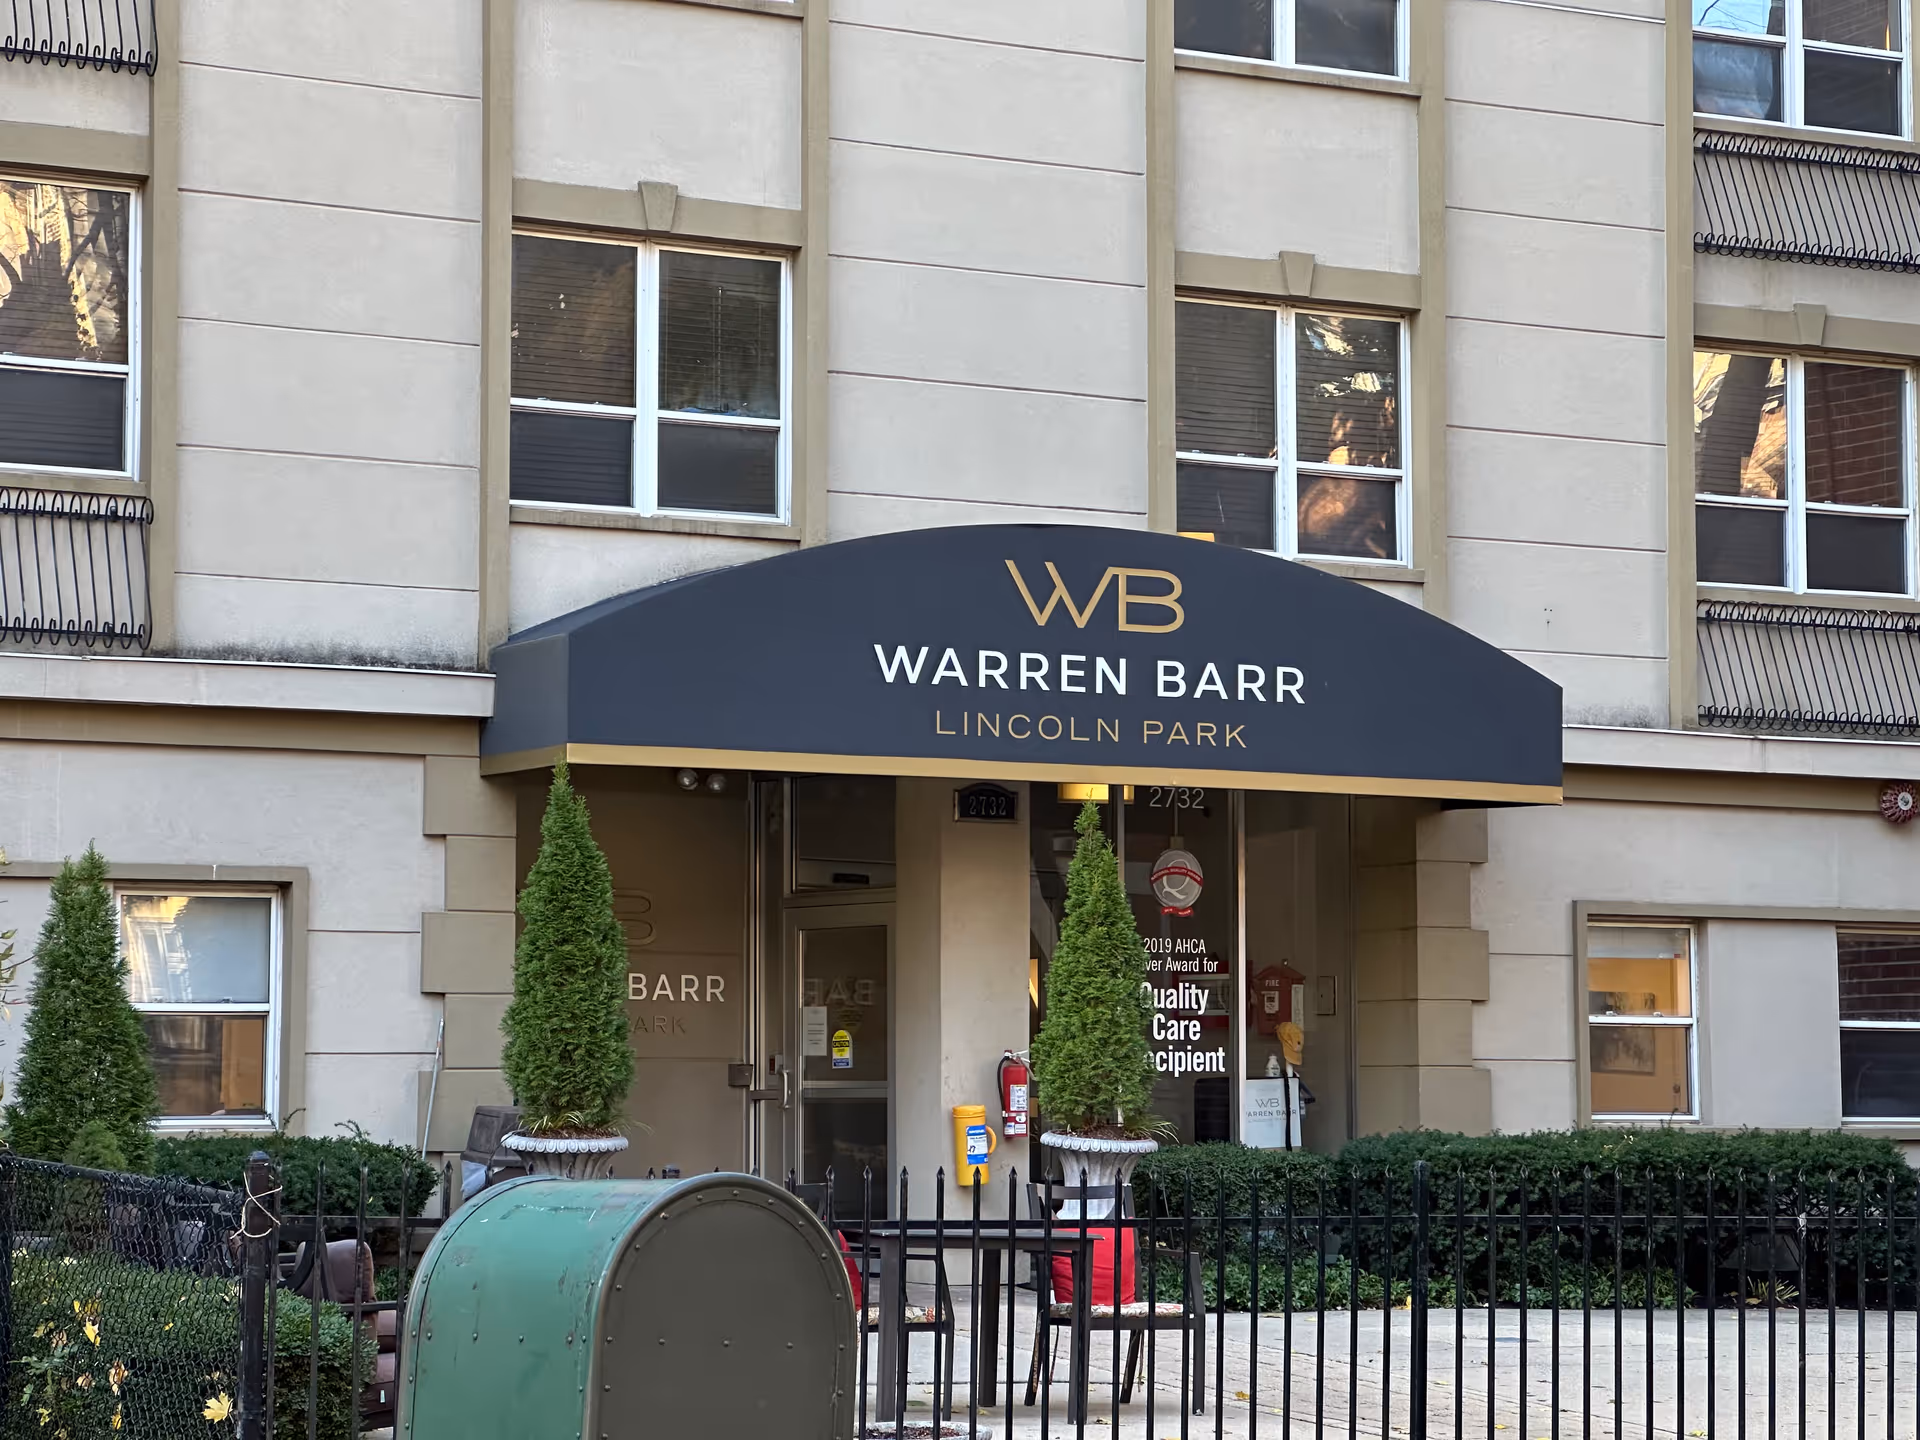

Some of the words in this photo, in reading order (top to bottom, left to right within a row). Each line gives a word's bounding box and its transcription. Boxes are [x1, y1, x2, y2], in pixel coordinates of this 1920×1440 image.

[1004, 559, 1185, 634] WB
[873, 643, 1128, 696] WARREN
[1156, 660, 1306, 704] BARR
[935, 710, 1120, 743] LINCOLN
[1143, 720, 1247, 748] PARK
[969, 795, 1006, 816] 2732
[1149, 786, 1205, 809] 2732
[1143, 937, 1172, 953] 2019
[1175, 938, 1206, 954] AHCA
[1144, 959, 1163, 972] ver
[1165, 956, 1199, 972] Award
[1202, 957, 1219, 973] for
[627, 973, 725, 1002] BARR
[632, 1015, 687, 1035] ARK
[1152, 1012, 1201, 1041] Care
[1143, 1044, 1226, 1078] ecipient
